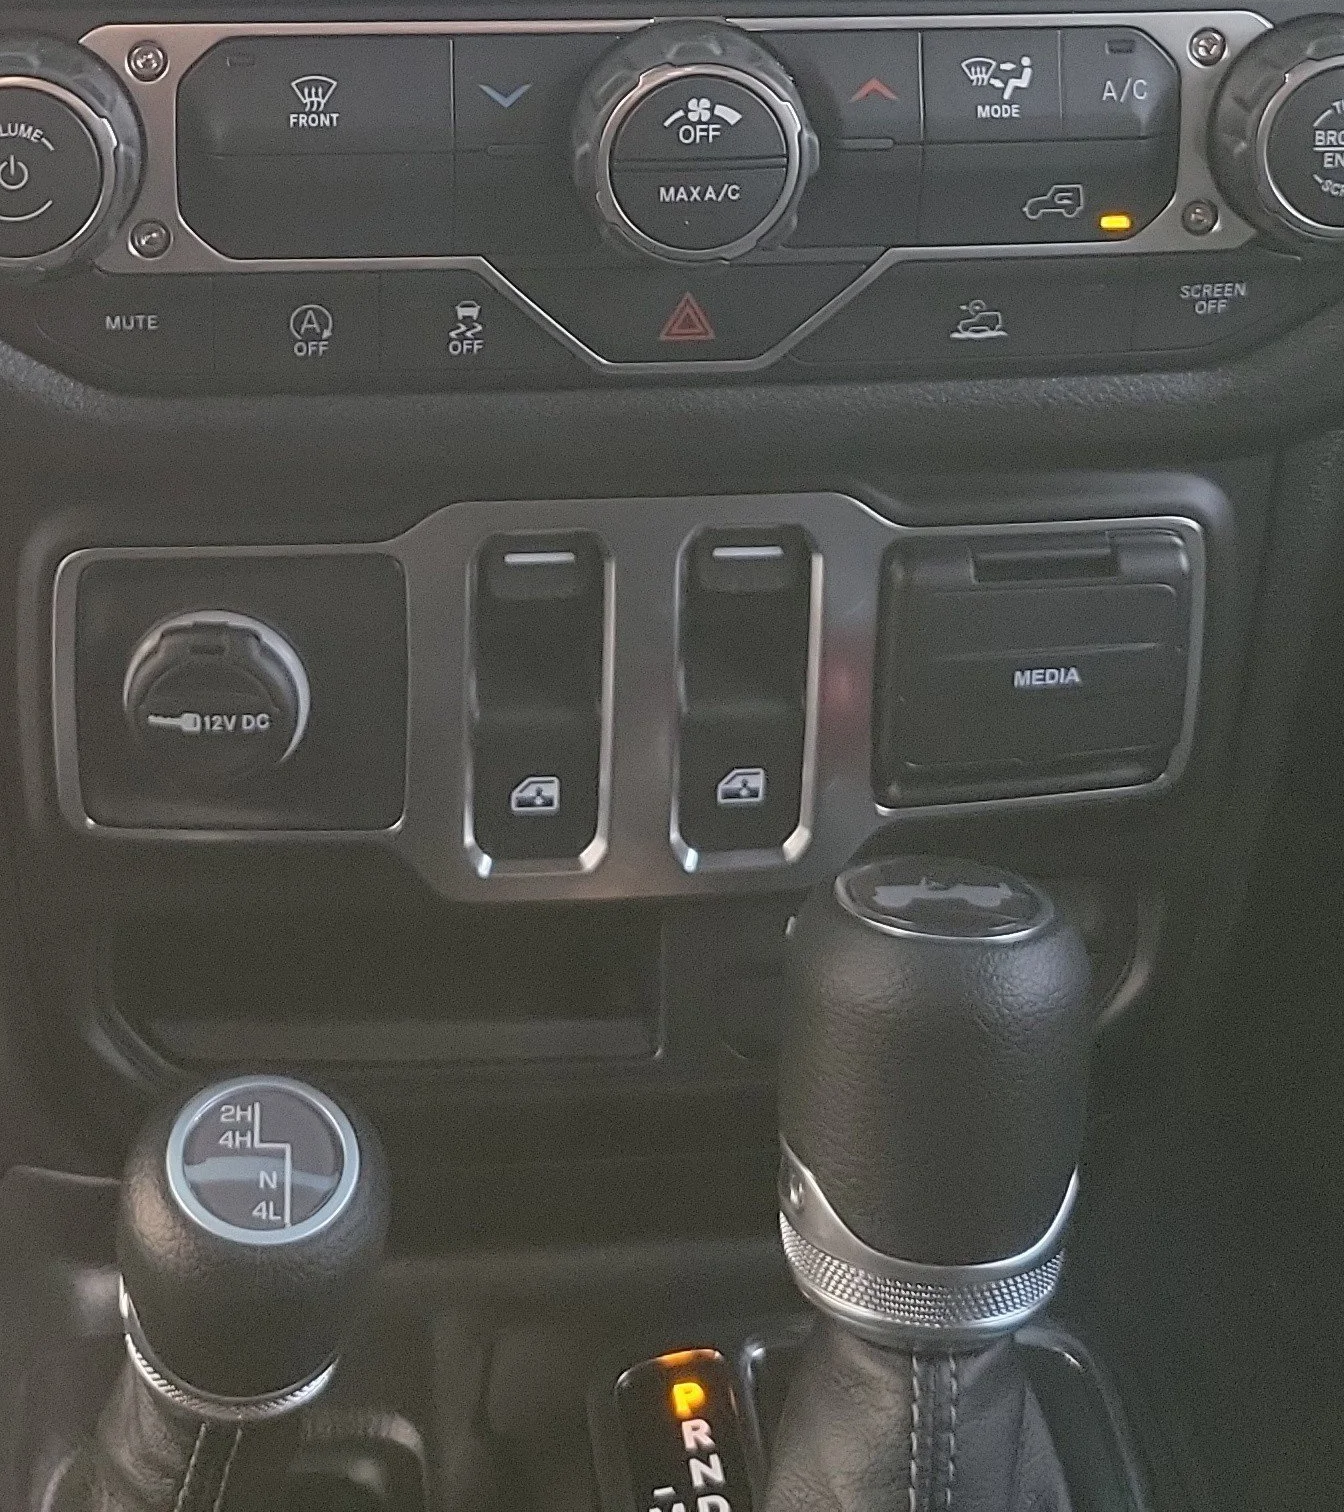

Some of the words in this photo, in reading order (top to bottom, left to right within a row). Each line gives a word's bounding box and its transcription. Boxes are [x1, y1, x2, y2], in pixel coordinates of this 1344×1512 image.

[1102, 79, 1149, 101] A/C
[289, 113, 340, 128] FRONT
[977, 104, 1020, 119] MODE
[679, 124, 721, 145] OFF
[1180, 283, 1246, 299] SCREEN
[1195, 299, 1228, 315] OFF
[105, 314, 159, 331] MUTE
[293, 341, 329, 357] OFF
[448, 339, 484, 355] OFF
[1012, 664, 1081, 689] MEDIA
[203, 712, 237, 731] 12V
[241, 712, 270, 731] DC
[220, 1105, 252, 1122] 2H
[219, 1130, 250, 1149] 4H
[258, 1171, 277, 1189] N
[252, 1201, 282, 1221] 4L
[672, 1382, 705, 1419] P
[682, 1419, 716, 1452] R
[689, 1453, 725, 1489] N
